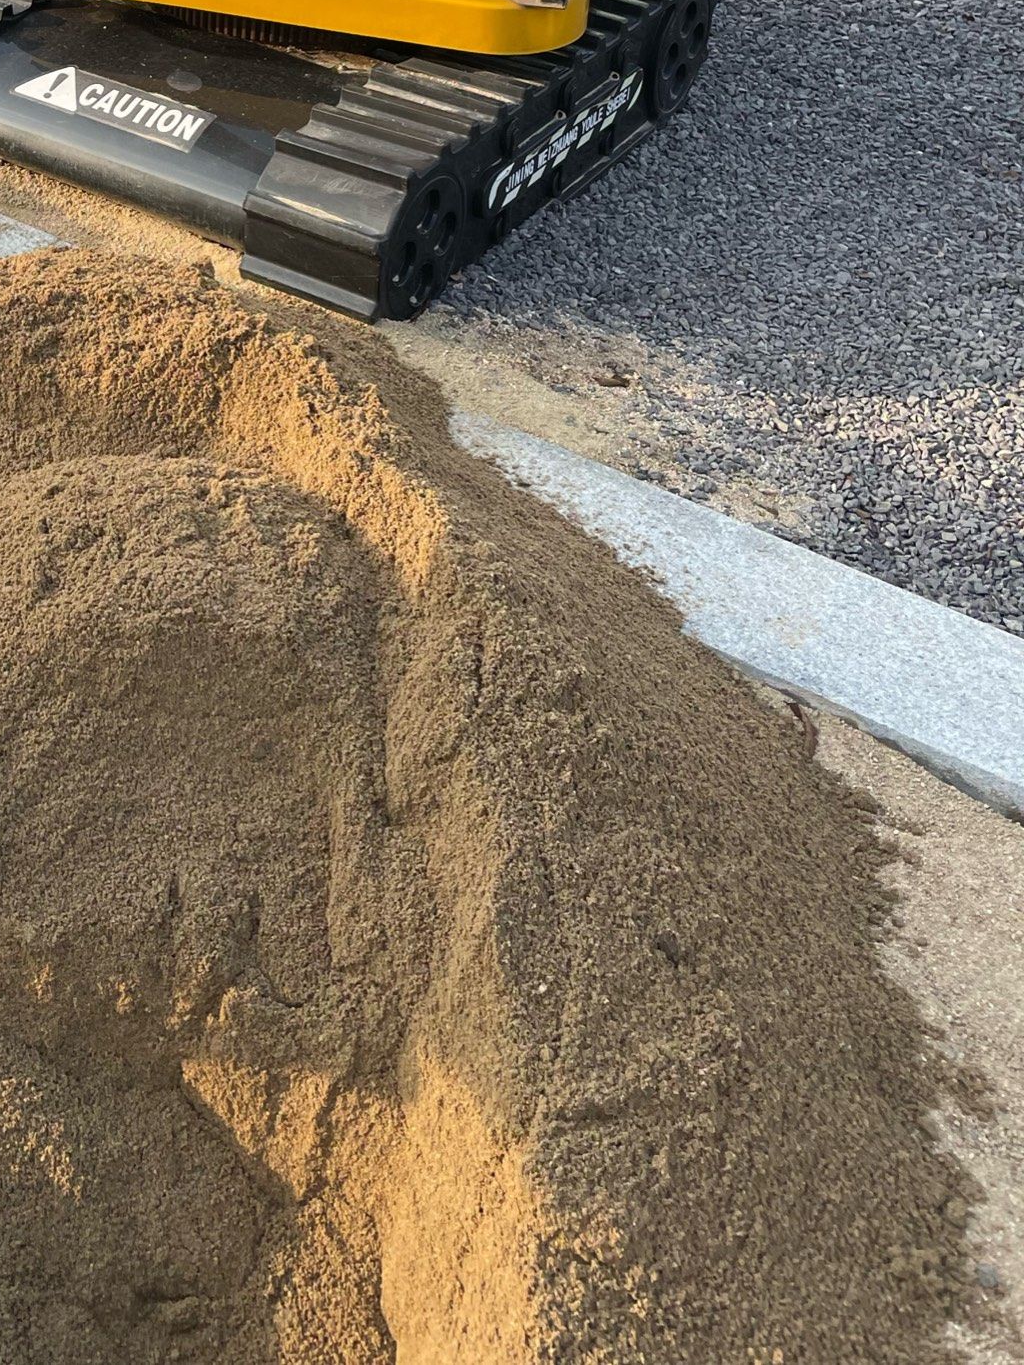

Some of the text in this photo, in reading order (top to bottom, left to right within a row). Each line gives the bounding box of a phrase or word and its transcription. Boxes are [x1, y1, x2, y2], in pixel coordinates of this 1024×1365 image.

[78, 83, 205, 140] CAUTION
[505, 159, 535, 193] JINING
[537, 126, 579, 169] WEIZHUANG
[581, 106, 604, 134] YOULE
